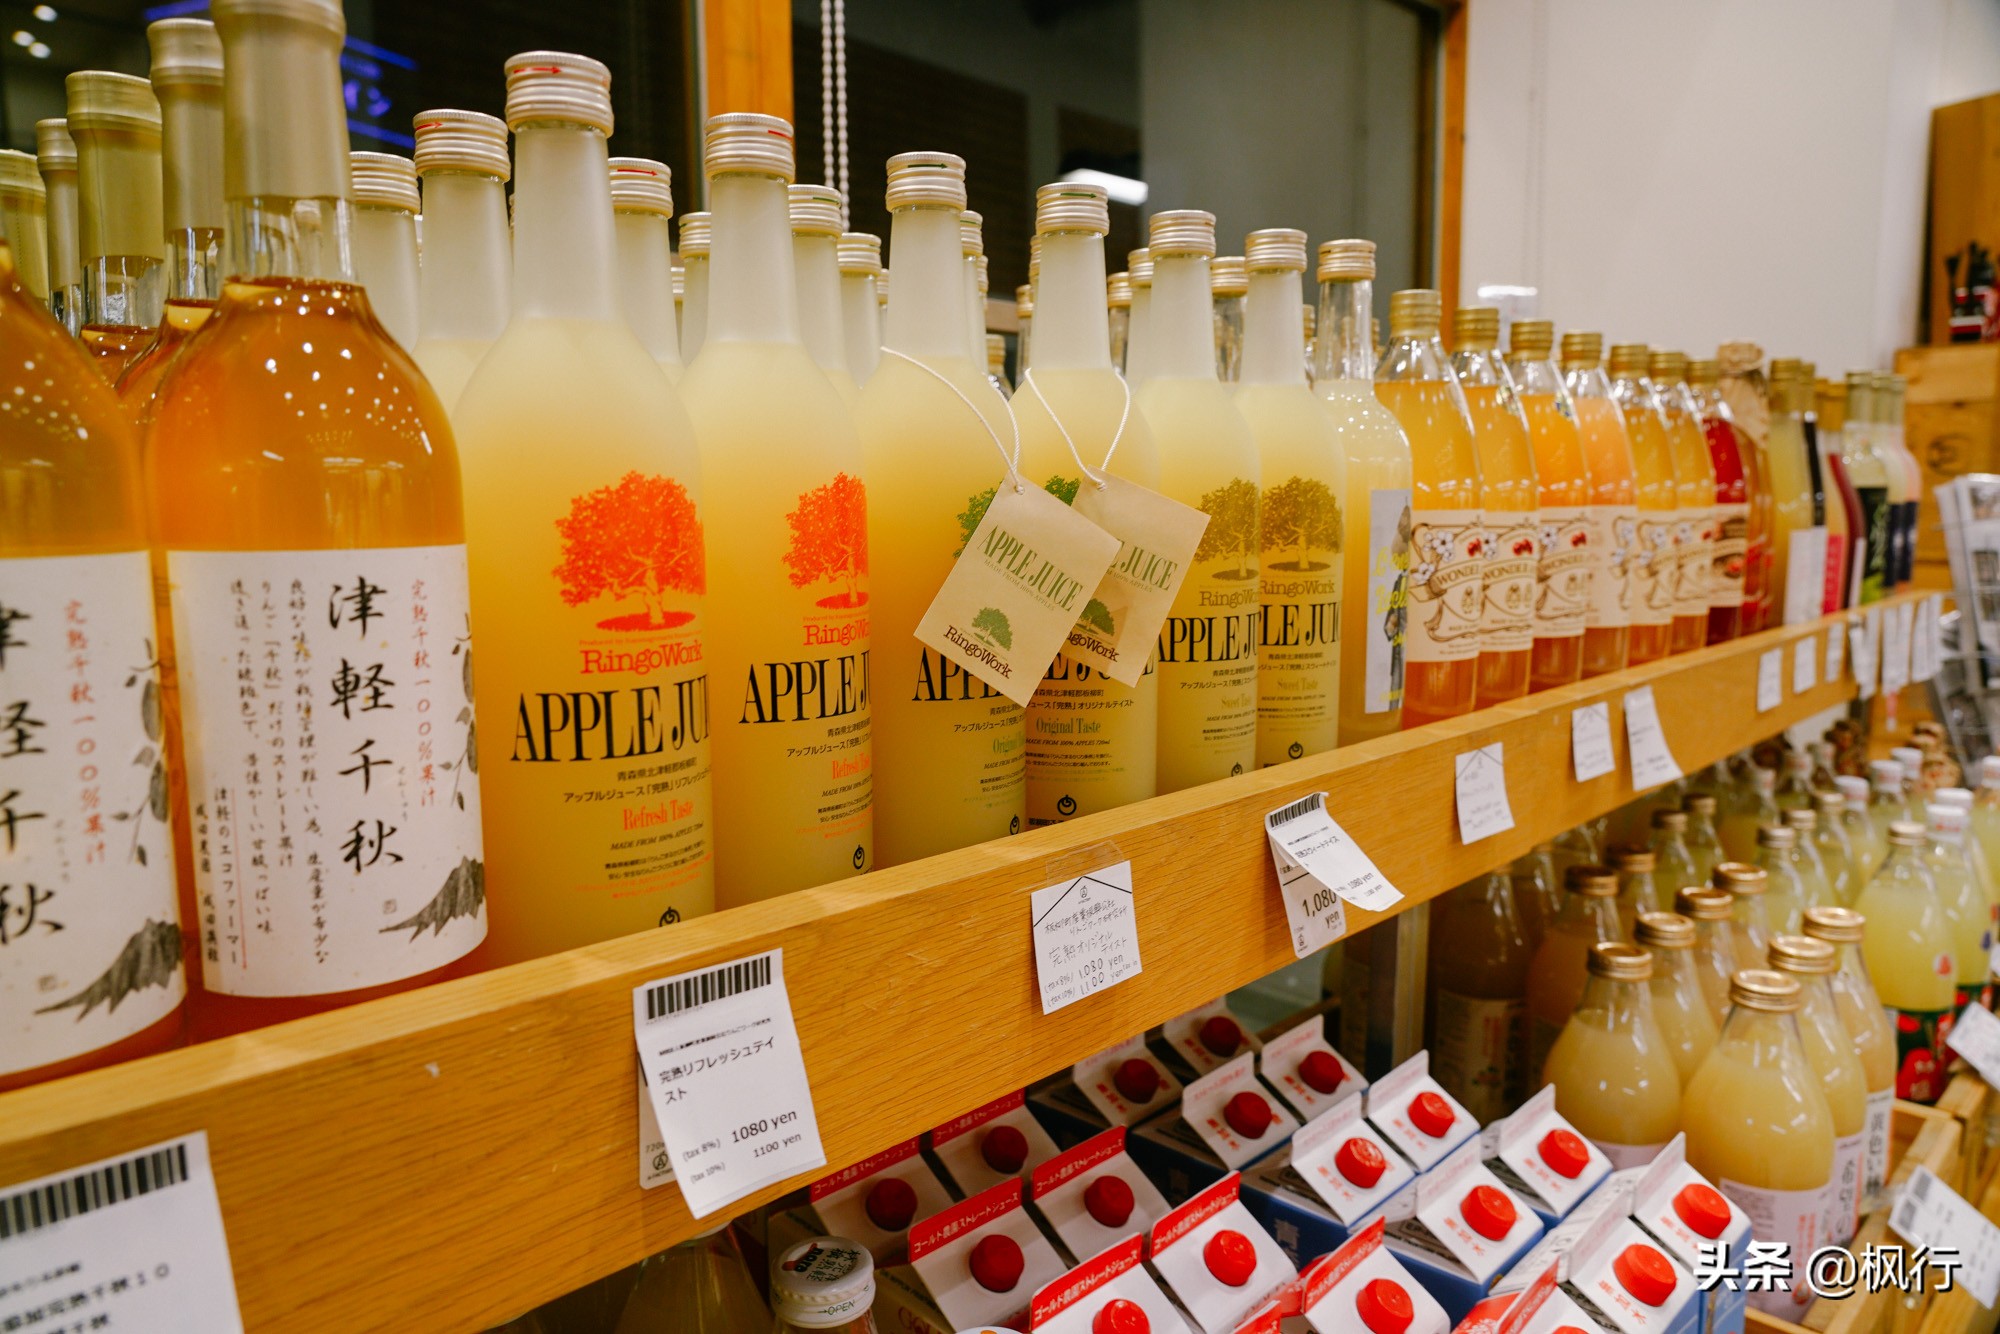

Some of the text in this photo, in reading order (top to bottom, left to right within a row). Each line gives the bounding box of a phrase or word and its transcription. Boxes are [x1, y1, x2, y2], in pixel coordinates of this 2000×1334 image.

[977, 524, 1085, 612] APPLE JUICE
[1120, 546, 1178, 592] JUICE
[579, 638, 704, 676] RingoWork
[942, 624, 1013, 680] RingoWork
[738, 654, 857, 724] APPLE
[327, 575, 404, 874] 津軽千秋
[510, 685, 664, 762] APPLE
[1035, 715, 1102, 736] Original Taste
[622, 802, 669, 831] Refresh
[1302, 886, 1337, 918] 1,080
[1325, 911, 1340, 929] yen
[1100, 937, 1128, 954] テイスト
[1107, 953, 1124, 970] yen
[658, 1035, 775, 1084] 完熟リフレッシュテイ
[664, 1087, 688, 1105] スト
[732, 1119, 769, 1144] 1080
[770, 1109, 798, 1131] yen
[753, 1140, 780, 1159] 1100
[781, 1132, 803, 1150] yen
